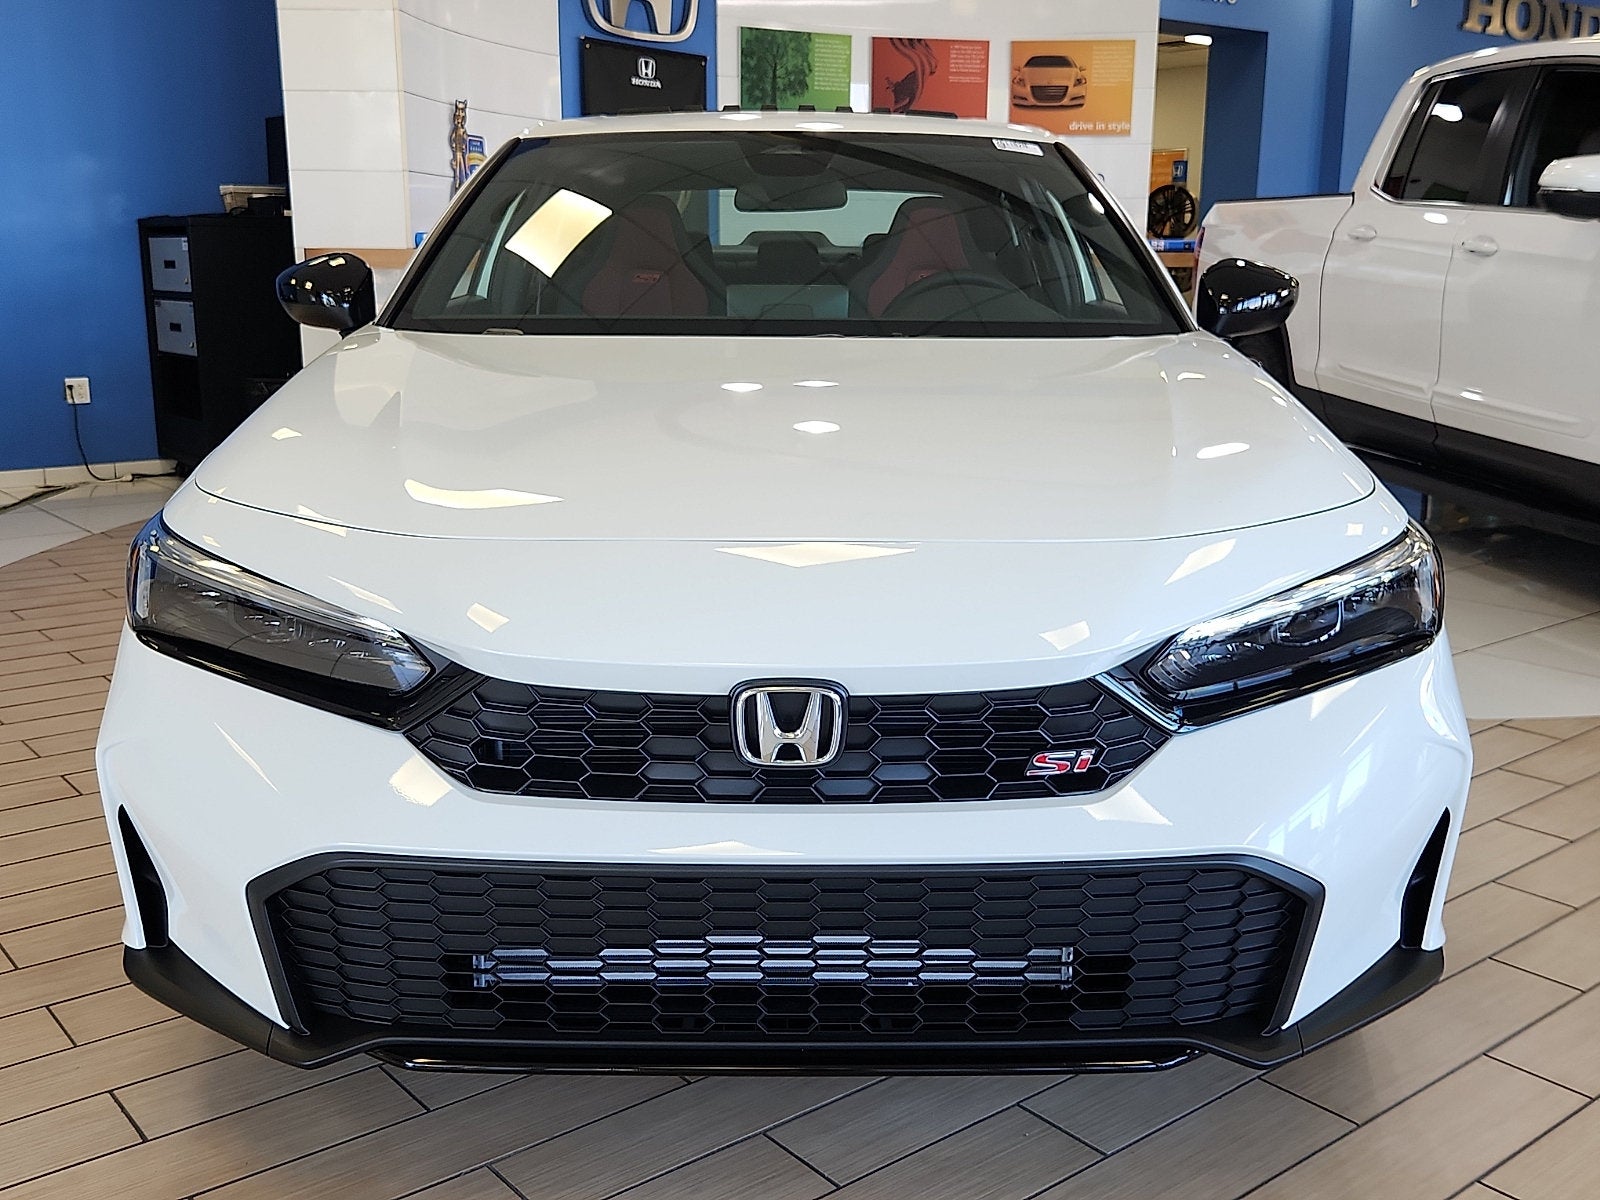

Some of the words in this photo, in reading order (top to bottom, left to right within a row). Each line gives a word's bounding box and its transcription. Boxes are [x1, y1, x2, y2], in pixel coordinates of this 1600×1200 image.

[631, 77, 662, 89] HONDA
[1069, 121, 1094, 131] drive
[1095, 121, 1105, 131] in
[1107, 121, 1131, 133] style
[1026, 749, 1095, 776] Si
